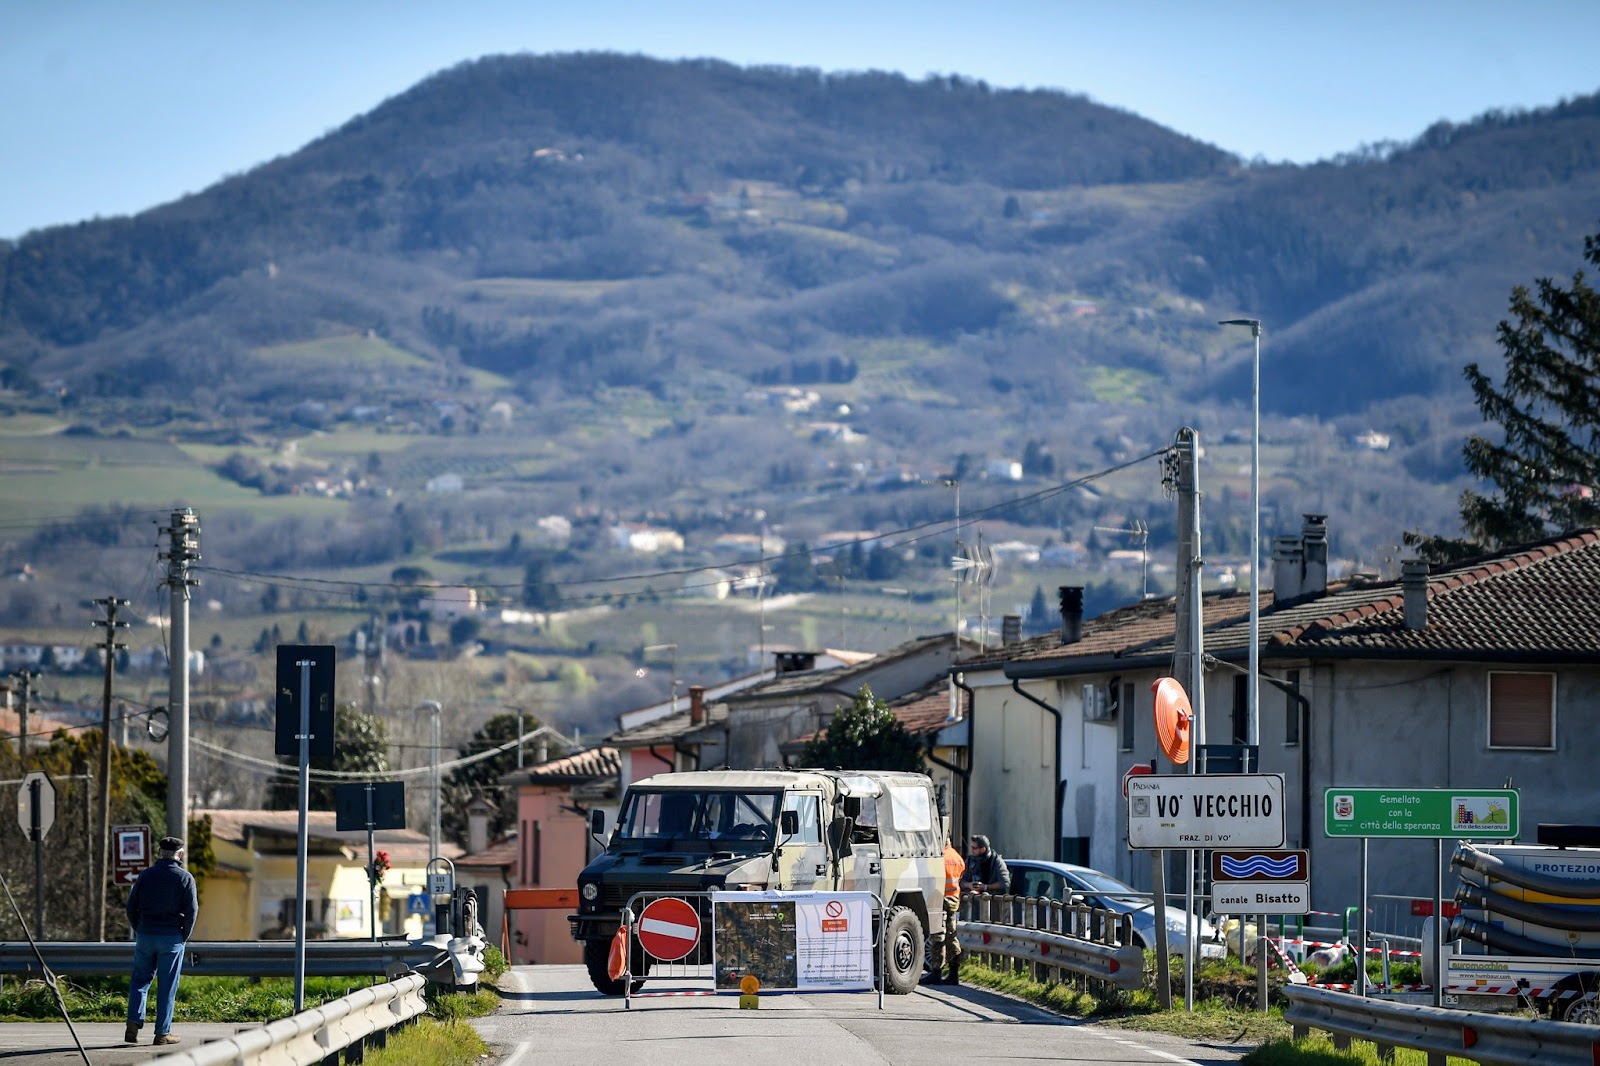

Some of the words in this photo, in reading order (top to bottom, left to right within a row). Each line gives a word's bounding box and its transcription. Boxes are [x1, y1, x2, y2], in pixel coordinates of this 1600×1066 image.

[1379, 794, 1421, 804] Gemellato
[1194, 794, 1272, 818] VECCHIO
[1404, 808, 1412, 817] la
[1360, 821, 1381, 830] città
[1382, 821, 1402, 830] della
[1404, 821, 1441, 831] speranza
[1179, 834, 1201, 842] FRAZ.
[1205, 834, 1213, 842] DI
[1218, 834, 1231, 842] VO'
[1220, 895, 1248, 904] canale
[1255, 893, 1301, 904] Bisatto
[1459, 972, 1511, 980] www.humbaur.com
